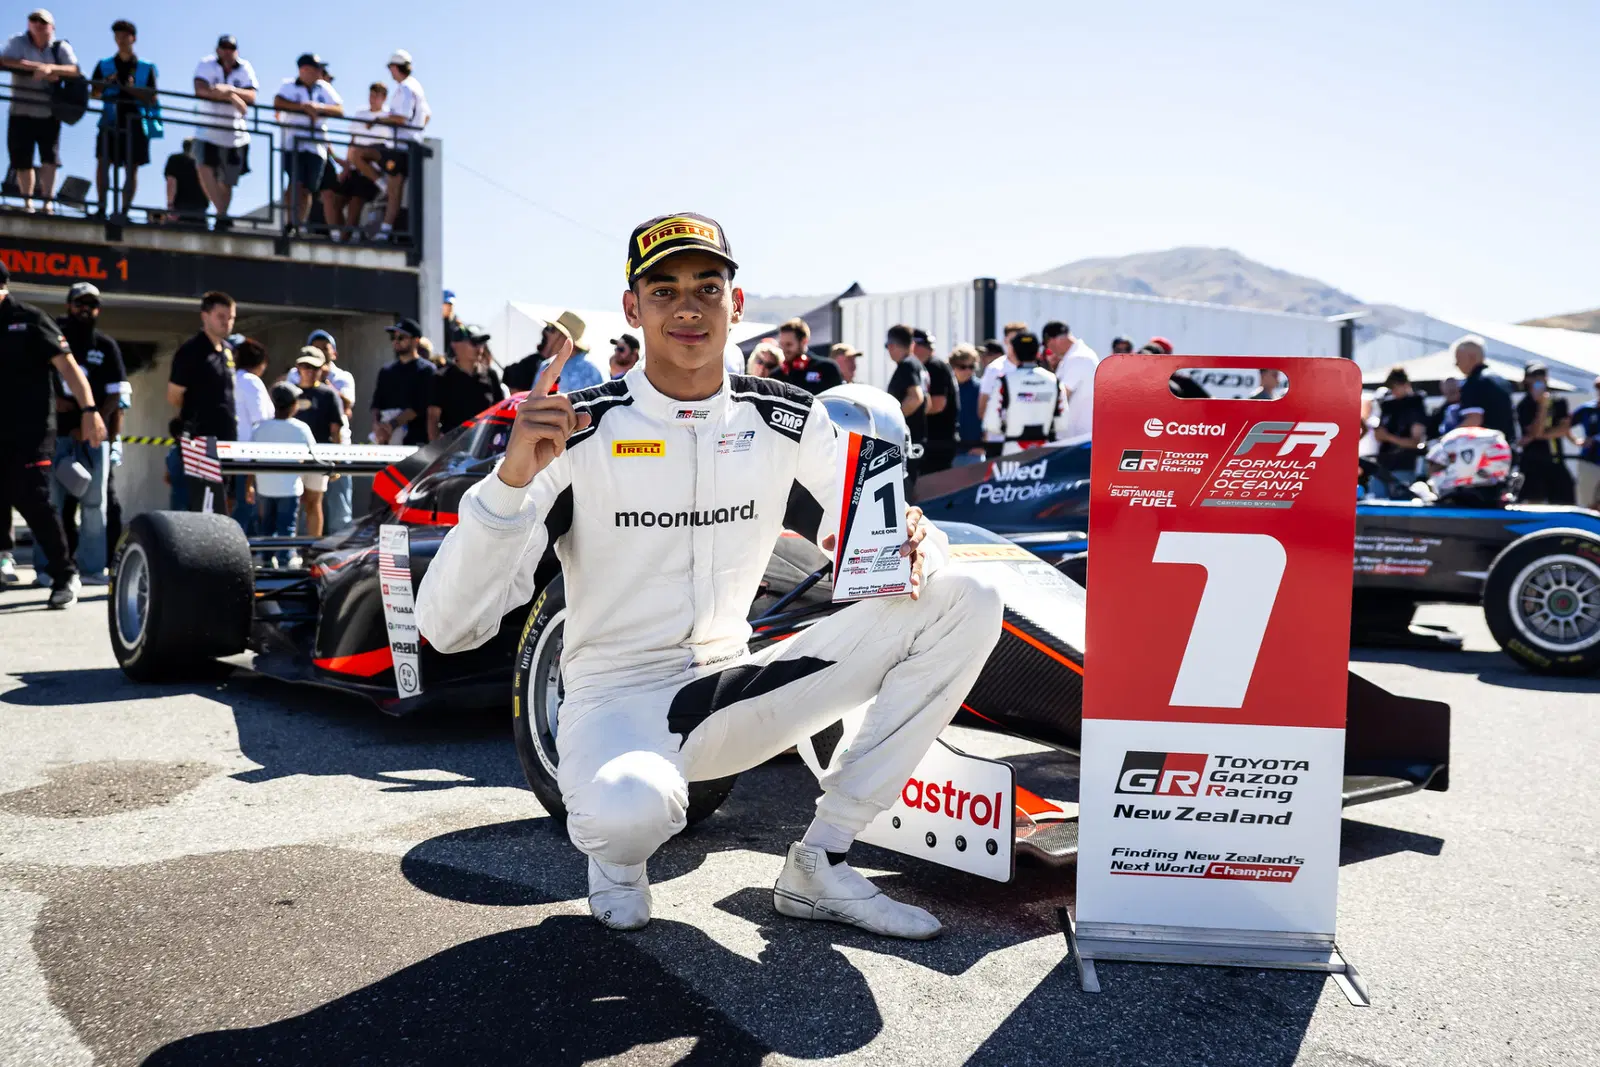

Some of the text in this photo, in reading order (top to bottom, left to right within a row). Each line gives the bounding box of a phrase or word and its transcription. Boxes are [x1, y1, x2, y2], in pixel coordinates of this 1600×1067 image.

[642, 221, 716, 250] PIRELLI
[116, 259, 128, 280] 1
[771, 410, 803, 430] OMP
[1166, 422, 1226, 436] Castrol
[616, 442, 661, 454] PIRELLI
[1233, 421, 1340, 458] FR
[869, 445, 900, 471] GR
[1119, 455, 1161, 473] GR
[1164, 451, 1209, 459] TOYOTA
[1226, 459, 1317, 469] FORMULA
[984, 459, 1049, 482] Allied
[1160, 465, 1202, 474] Racing
[1219, 469, 1310, 480] REGIONAL
[852, 486, 862, 505] 2026
[858, 466, 867, 485] ROUND
[1110, 489, 1174, 498] SUSTAINABLE
[1214, 479, 1303, 491] OCEANIA
[1129, 498, 1177, 507] FUEL
[1209, 490, 1300, 499] TROPHY
[874, 482, 897, 528] 1
[392, 606, 414, 614] YUASA
[1152, 531, 1287, 709] 1
[1214, 755, 1310, 771] TOYOTA
[1117, 762, 1203, 798] GR
[1209, 771, 1298, 785] GAZOO
[1205, 784, 1293, 803] Racing
[898, 777, 1002, 830] astrol
[1113, 804, 1293, 825] New Zealand
[1111, 847, 1305, 865] Finding New Zealand's
[1110, 861, 1293, 879] Next World Champion
